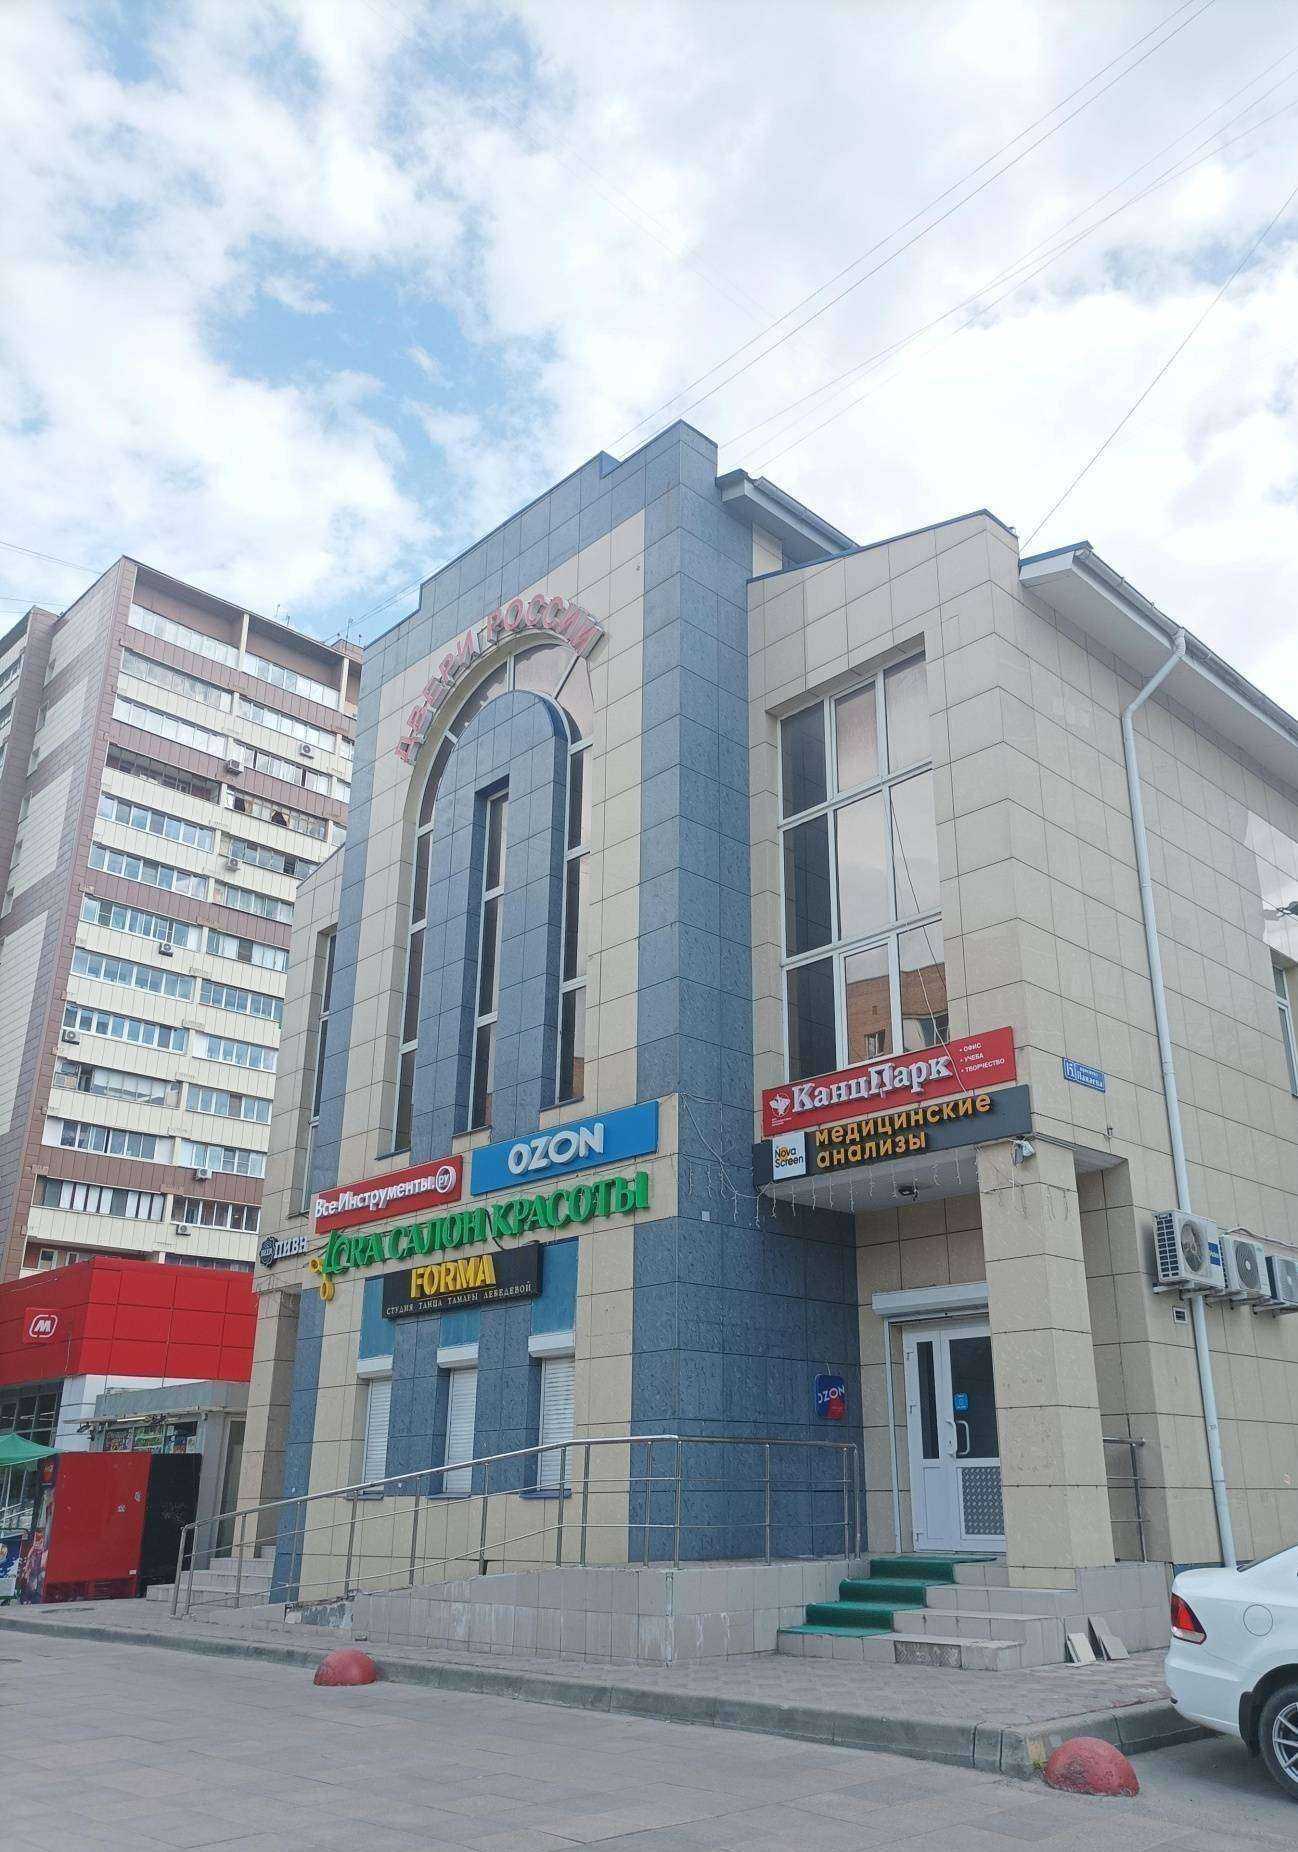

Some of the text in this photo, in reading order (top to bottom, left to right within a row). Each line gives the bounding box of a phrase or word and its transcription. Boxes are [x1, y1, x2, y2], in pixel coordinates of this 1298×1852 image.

[487, 594, 605, 658] РОССИИ
[792, 1056, 953, 1112] КанцПарк
[815, 1093, 991, 1146] медицинские
[507, 1122, 605, 1175] OZON
[775, 1146, 797, 1158] Nova
[775, 1156, 804, 1168] Screen
[816, 1131, 926, 1168] анализы
[391, 1207, 487, 1255] САЛОН
[491, 1171, 650, 1239] КРАСОТЫ
[386, 1281, 531, 1315] СТУДИЯ ТАНЦА ТАМАРЫ ЛЕБЕДЕВОЙ
[410, 1254, 496, 1298] FORMA
[818, 1385, 845, 1404] OZON
